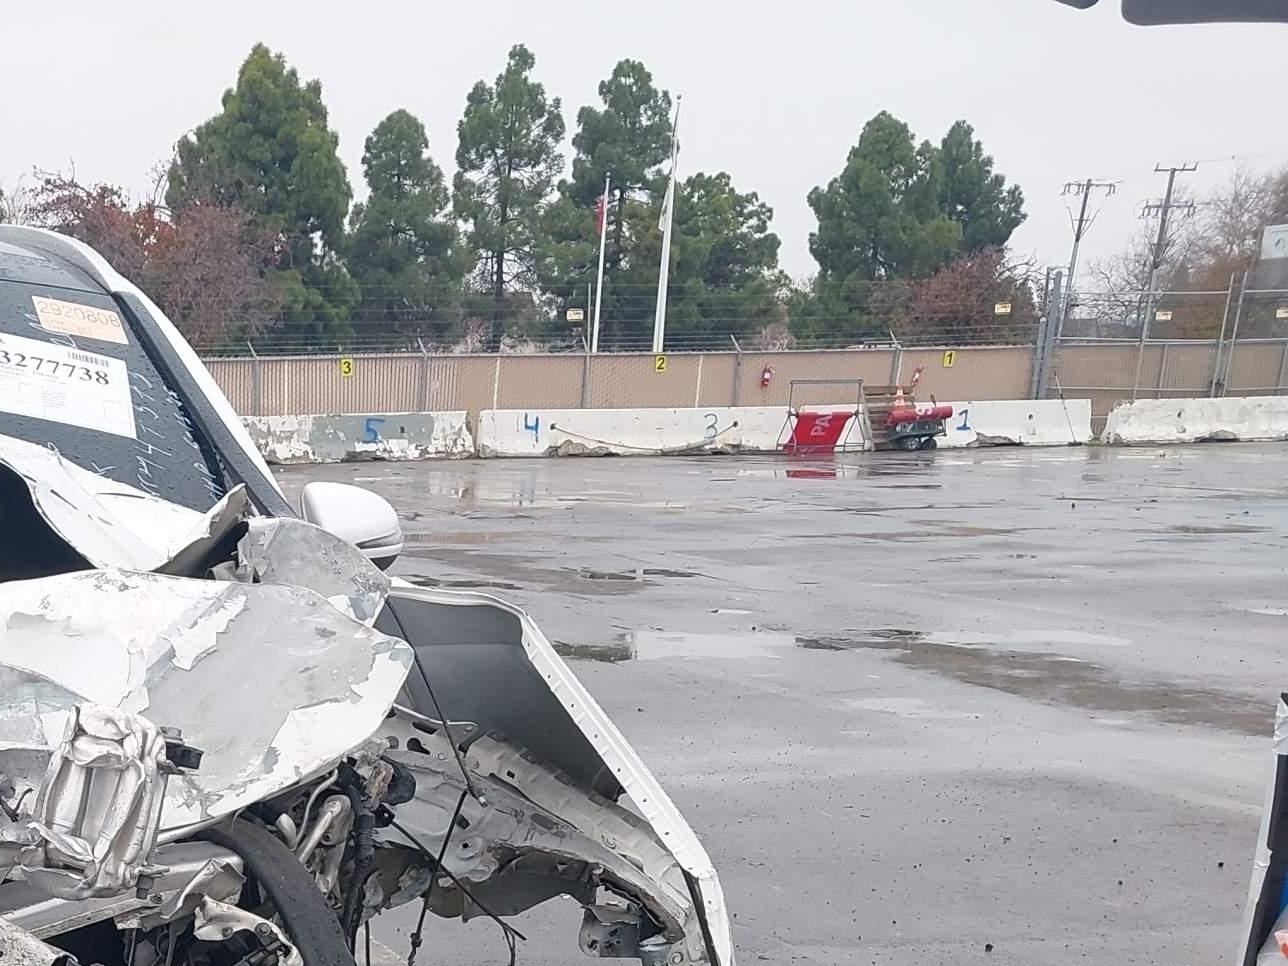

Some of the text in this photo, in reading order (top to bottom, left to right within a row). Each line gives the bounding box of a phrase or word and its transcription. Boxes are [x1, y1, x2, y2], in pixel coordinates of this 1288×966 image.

[343, 361, 352, 374] 3
[656, 357, 665, 370] 2
[946, 352, 953, 365] 1
[361, 417, 386, 444] 5
[524, 412, 539, 443] 4
[703, 413, 718, 438] 3
[956, 408, 971, 431] 1
